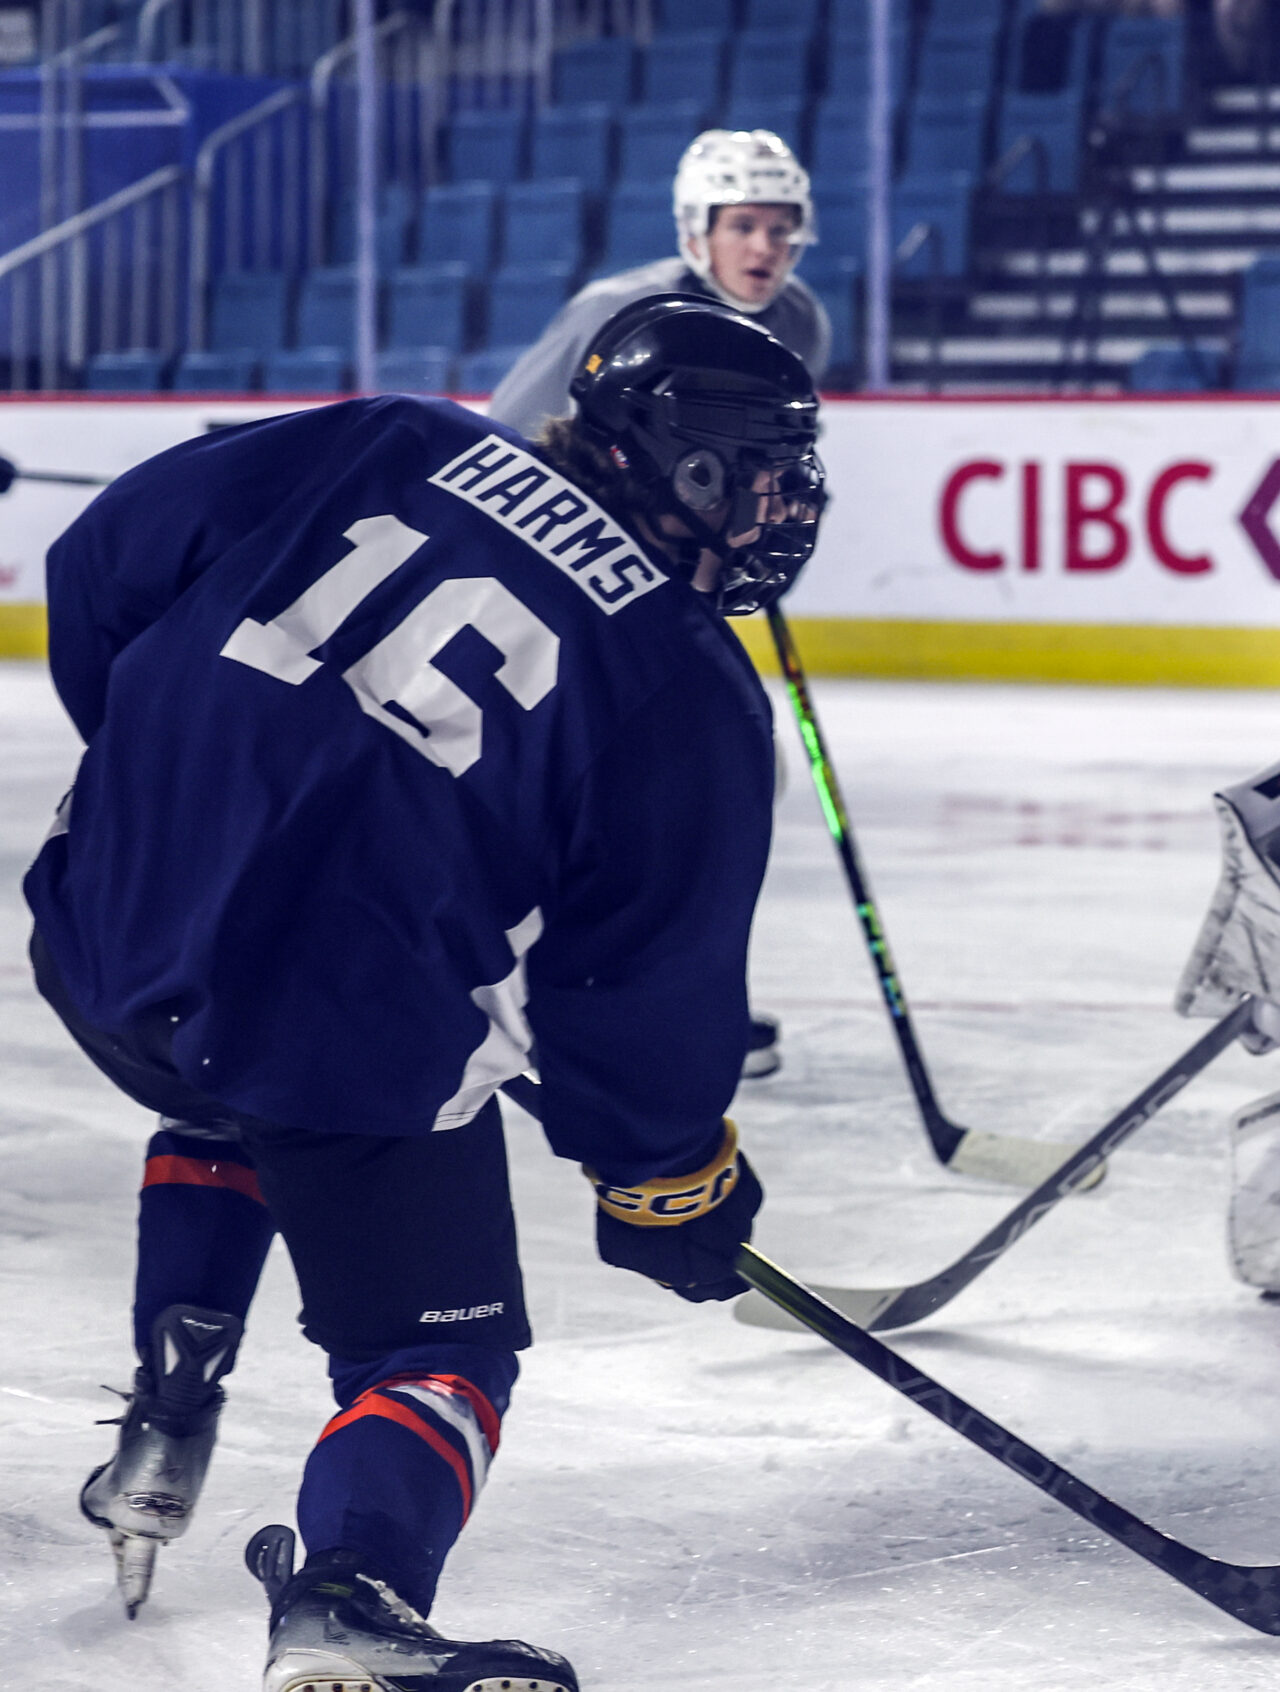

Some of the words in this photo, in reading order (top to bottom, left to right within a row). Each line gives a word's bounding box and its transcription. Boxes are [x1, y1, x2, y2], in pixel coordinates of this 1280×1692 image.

[439, 442, 655, 605] HARMS
[937, 457, 1216, 577] CIBC
[219, 513, 561, 778] 16
[418, 1301, 505, 1323] BAUER
